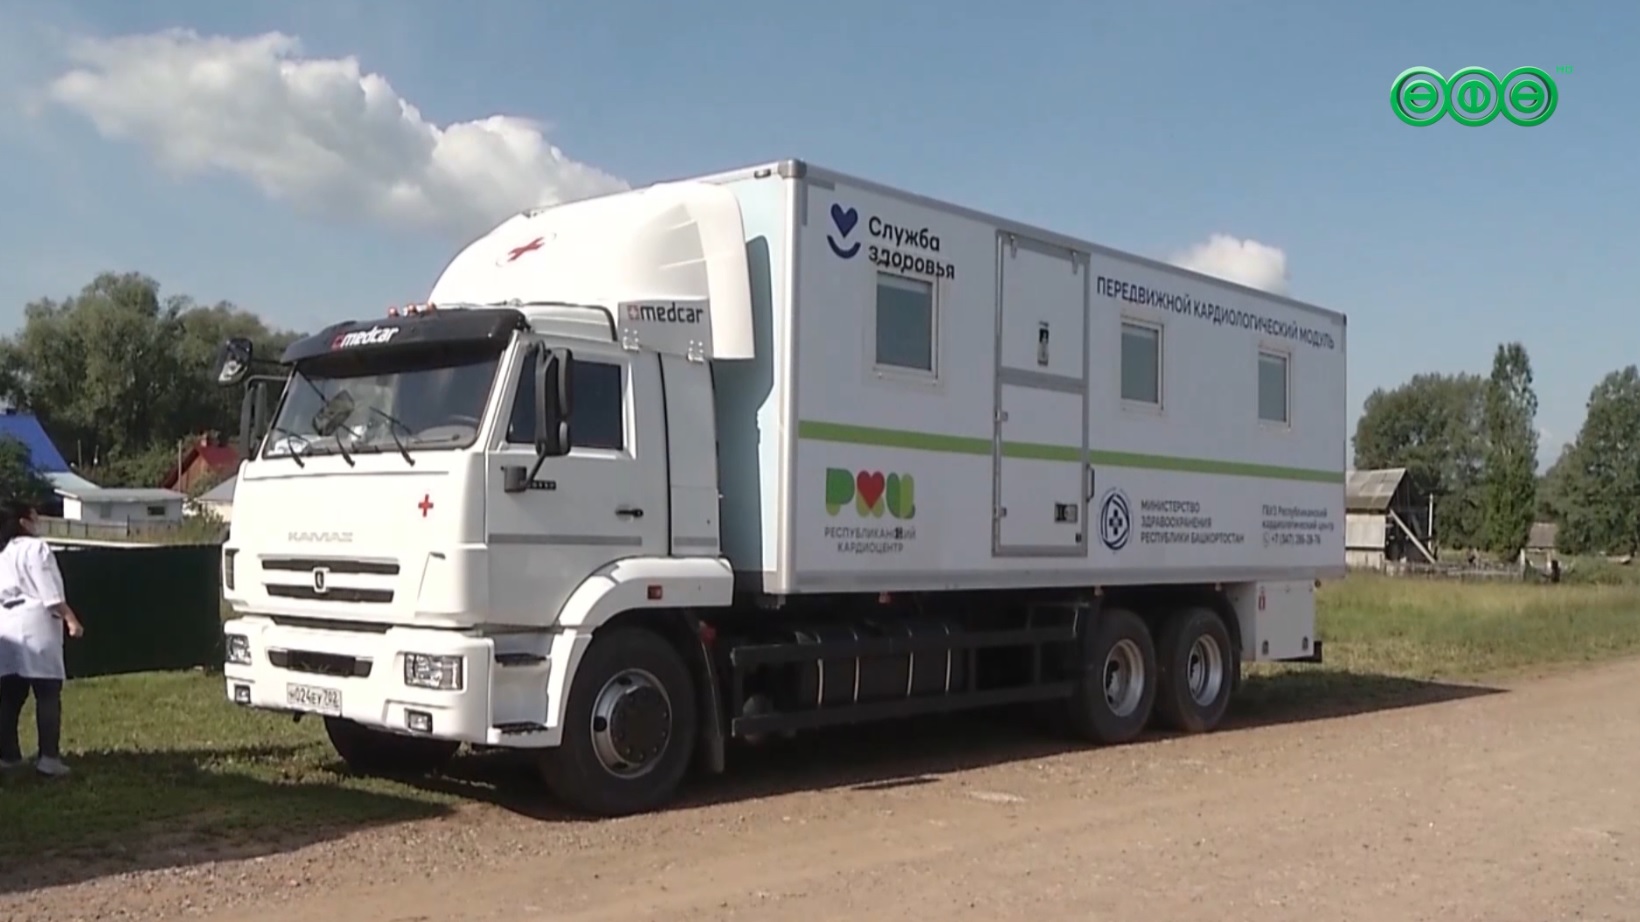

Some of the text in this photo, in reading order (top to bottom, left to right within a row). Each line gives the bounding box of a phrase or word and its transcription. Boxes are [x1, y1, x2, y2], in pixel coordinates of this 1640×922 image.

[868, 215, 941, 252] Служба
[868, 245, 955, 280] здоровья
[640, 301, 703, 324] medcar
[1097, 276, 1335, 350] ПЕРЕДВИЖНОЙ КАРДИОЛОГИЧЕСКИЙ МОДУЛЬ
[340, 325, 400, 348] medcar
[1141, 500, 1201, 514] МИНИСТЕРСТВО
[1141, 515, 1212, 529] ЗДРАВООХРАНЕНИЯ
[838, 541, 904, 554] КАРДИОЦЕНТР
[1141, 531, 1245, 545] РЕСПУБЛИКИ БАШКОРТОСТАН
